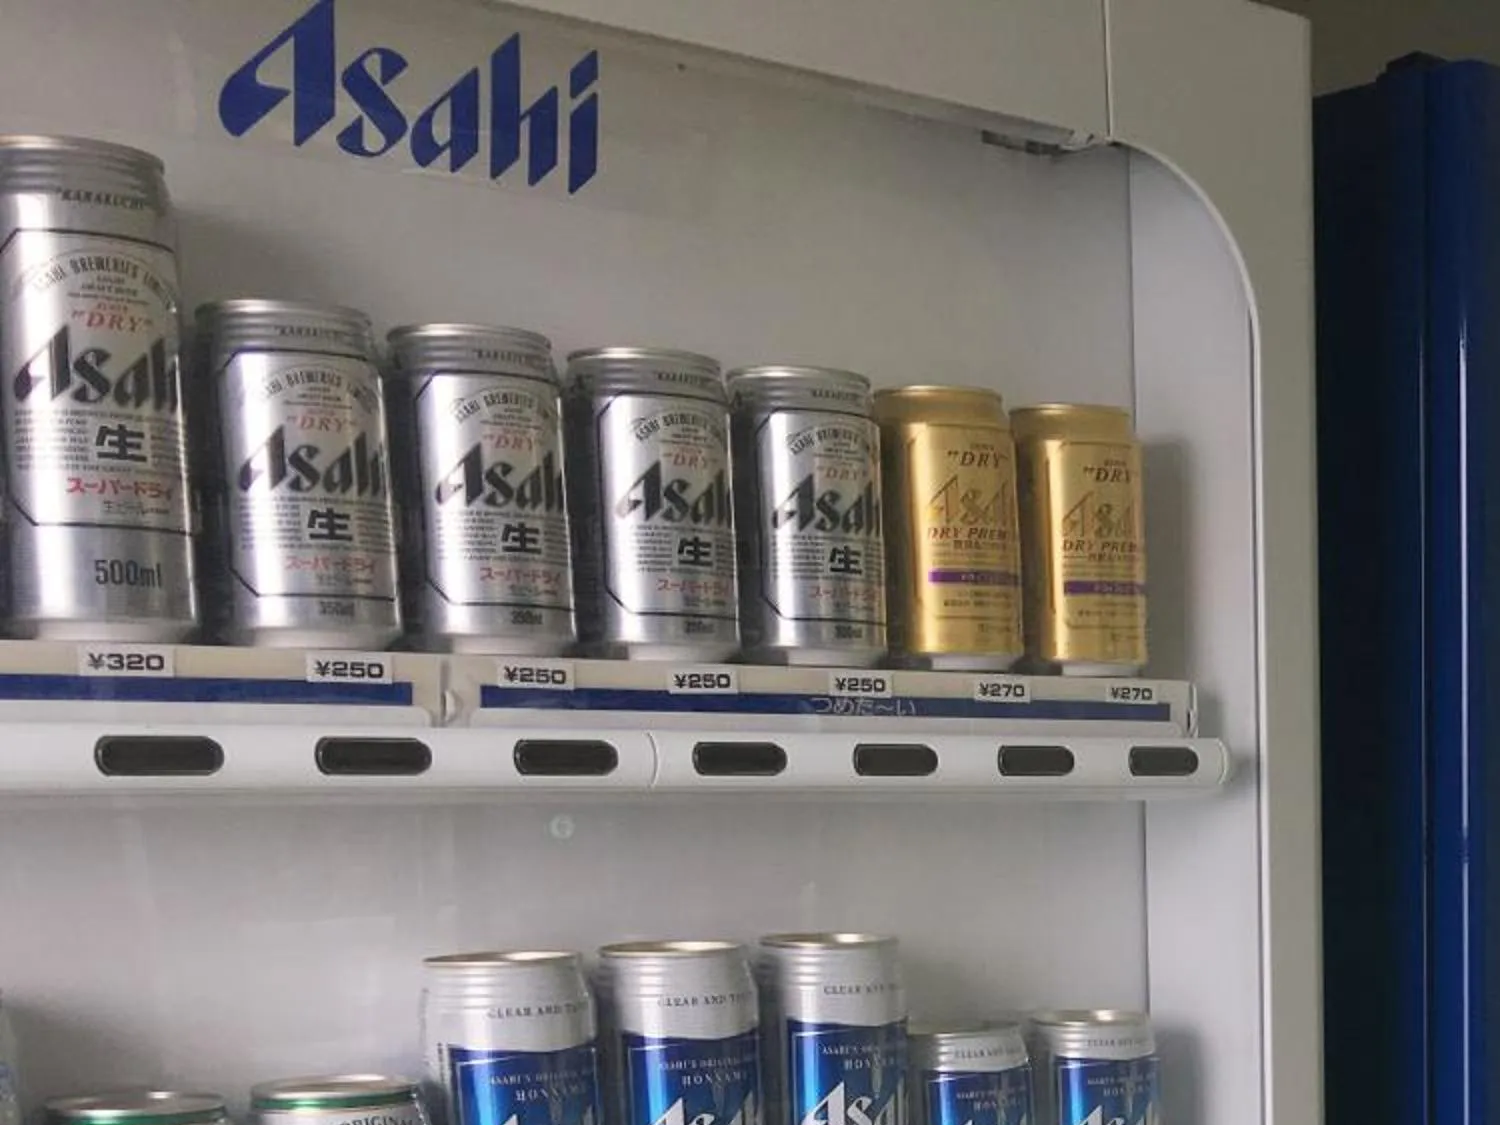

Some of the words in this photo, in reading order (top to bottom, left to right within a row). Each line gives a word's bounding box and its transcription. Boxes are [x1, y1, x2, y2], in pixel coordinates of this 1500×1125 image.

[219, 0, 600, 195] Asahi
[14, 325, 178, 412] Asah
[96, 424, 148, 465] 生
[238, 425, 388, 493] Asah
[66, 477, 173, 499] スーパードライ
[436, 442, 565, 511] Asah
[614, 460, 732, 528] Asah
[771, 474, 881, 538] Asah
[307, 508, 353, 542] 生
[502, 523, 543, 555] 生
[678, 537, 714, 567] 生
[829, 546, 863, 575] 生
[94, 561, 163, 588] 500ml
[88, 652, 165, 673] ¥320
[315, 661, 384, 679] ¥250
[504, 666, 567, 686] ¥250
[673, 673, 731, 690] ¥250
[835, 677, 886, 692] ¥250
[979, 683, 1026, 698] ¥270
[1111, 686, 1153, 701] ¥270
